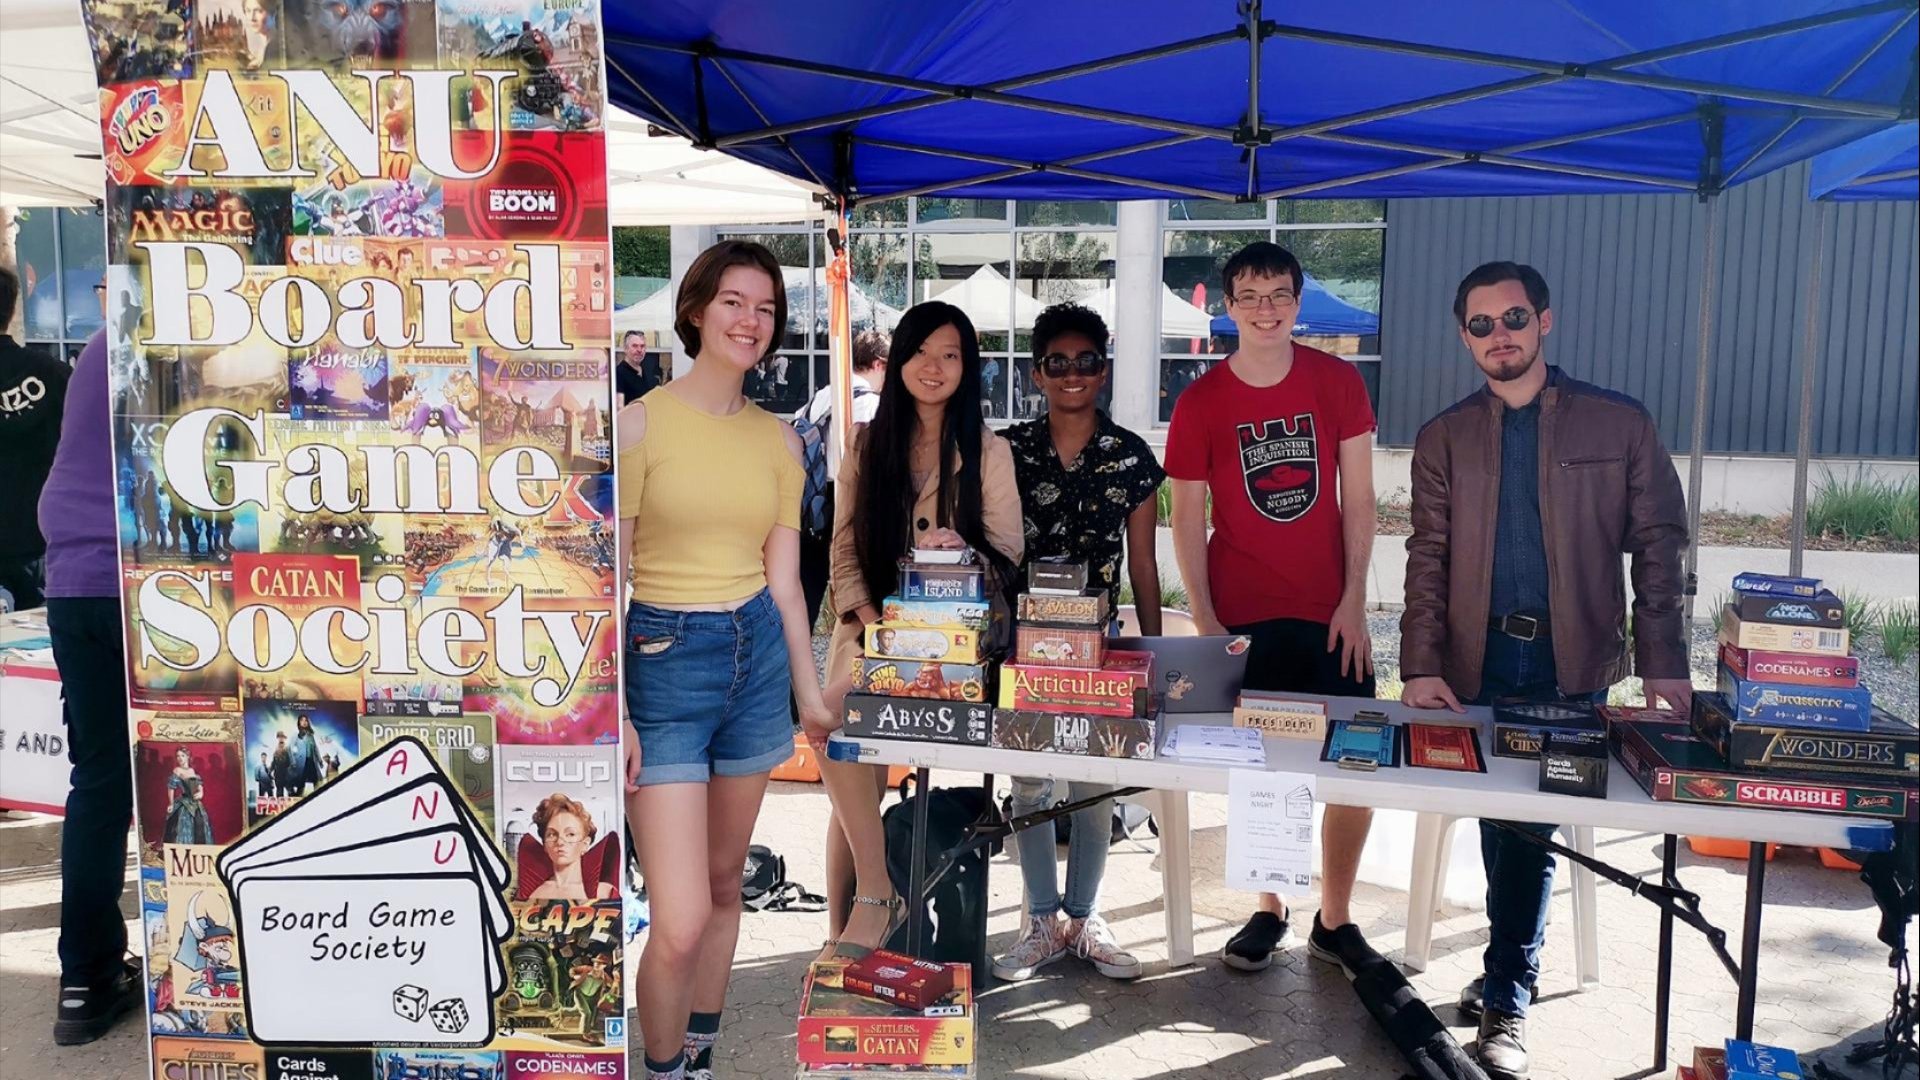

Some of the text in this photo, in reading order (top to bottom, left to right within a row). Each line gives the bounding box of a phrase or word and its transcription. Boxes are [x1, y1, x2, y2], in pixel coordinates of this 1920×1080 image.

[117, 103, 171, 155] UNO
[163, 69, 519, 179] ANU
[489, 195, 556, 213] BOOM
[128, 209, 255, 244] MAGIC
[182, 233, 254, 245] The Gathering
[290, 238, 363, 267] Clue
[135, 241, 575, 350] Board
[414, 354, 468, 366] PENGUINS
[507, 361, 600, 379] WONDERS
[1246, 441, 1309, 460] THE SPANISH
[1249, 448, 1310, 466] INQUISITION
[162, 406, 561, 517] Game
[1266, 494, 1308, 509] NOBODY
[250, 565, 344, 599] CATAN
[924, 586, 964, 598] ISLAND
[1045, 600, 1096, 615] AVALON
[1771, 610, 1816, 620] ALONE
[1779, 604, 1806, 612] NOT
[138, 568, 613, 708] Society
[1754, 663, 1831, 677] CODENAMES
[868, 677, 905, 694] TOKYO
[1015, 670, 1134, 698] Articulate!
[156, 723, 220, 740] Love Letter
[1054, 716, 1090, 739] DEAD
[1247, 717, 1314, 730] PRESIDENT
[16, 731, 64, 757] AND
[372, 723, 475, 747] POWER GRID
[1055, 738, 1089, 749] OF WINTER
[1760, 727, 1895, 764] 7 WONDERS
[386, 749, 408, 776] A
[1547, 758, 1571, 767] Cards
[1547, 765, 1577, 775] Against
[1546, 770, 1584, 783] Humanity
[1249, 791, 1276, 799] GAMES
[1740, 785, 1843, 806] SCRABBLE
[412, 790, 439, 821] N
[1250, 801, 1274, 809] NIGHT
[433, 837, 457, 865] U
[260, 901, 456, 932] Board Game
[310, 932, 426, 966] Society
[912, 960, 945, 972] KITTENS
[870, 1024, 915, 1034] SETTLERS
[863, 1037, 920, 1055] CATAN
[277, 1056, 327, 1071] Cards
[515, 1058, 618, 1075] CODENAMES
